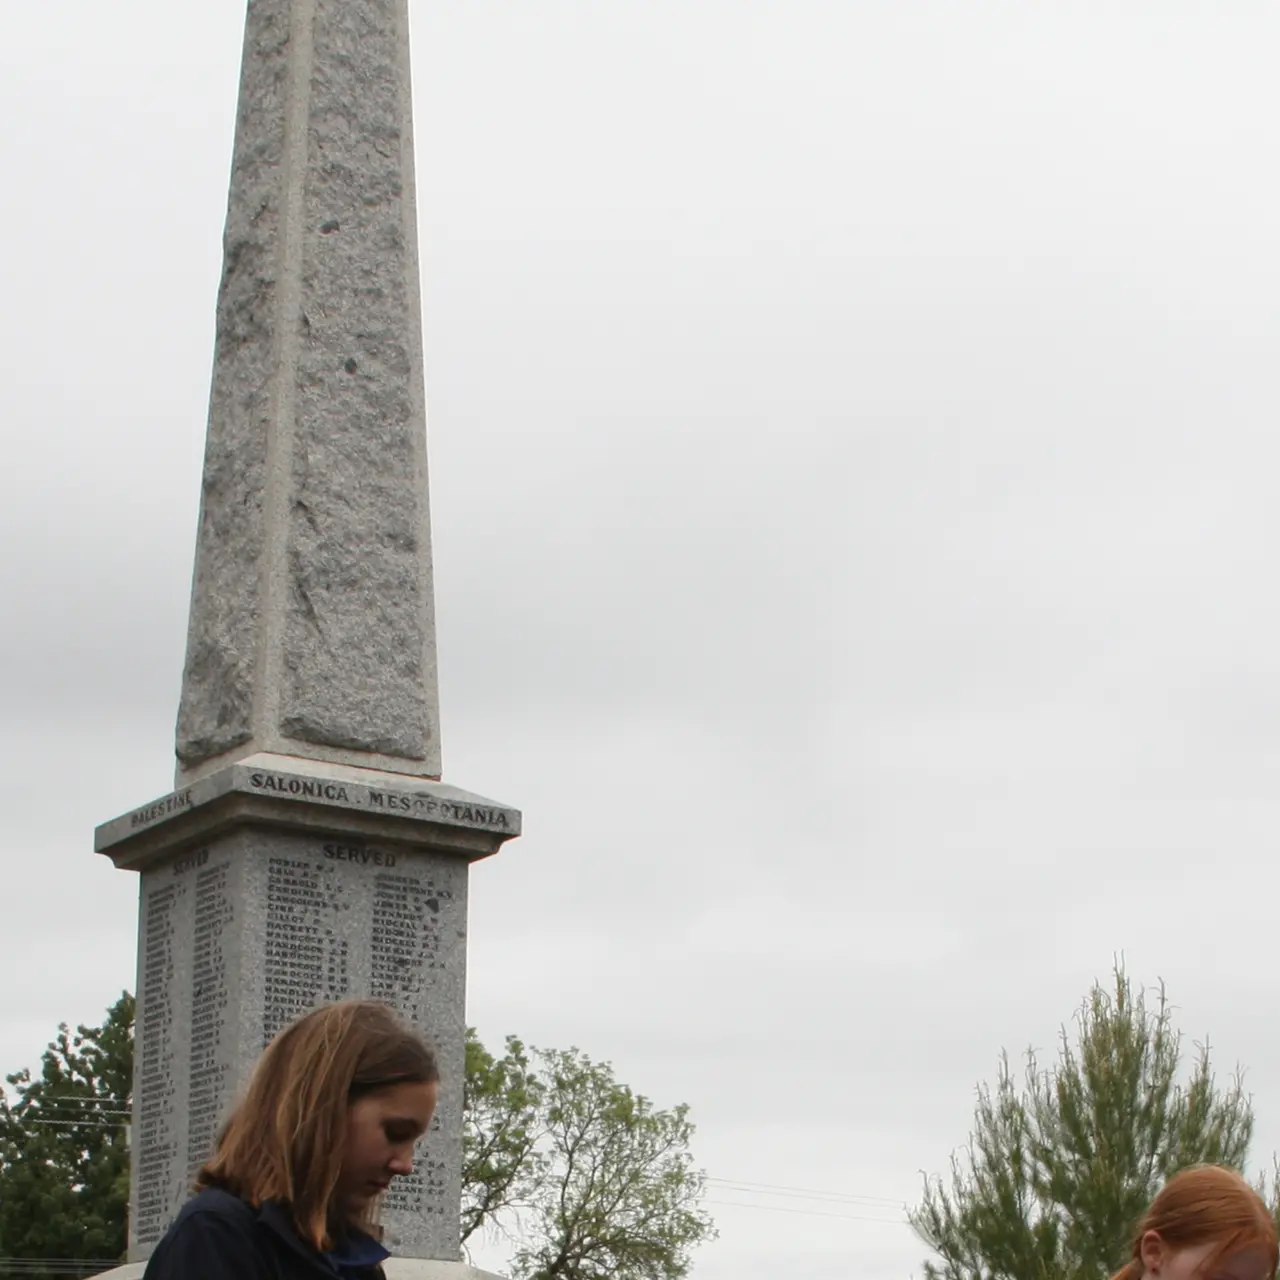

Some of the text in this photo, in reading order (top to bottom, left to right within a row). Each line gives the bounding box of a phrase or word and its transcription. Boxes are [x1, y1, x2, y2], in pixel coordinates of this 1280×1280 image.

[251, 773, 349, 802] SALONICA
[323, 844, 396, 868] SERVED
[266, 941, 323, 954] HANDCOCK
[265, 977, 322, 990] HANDCOCK
[265, 986, 316, 998] HANDLEY
